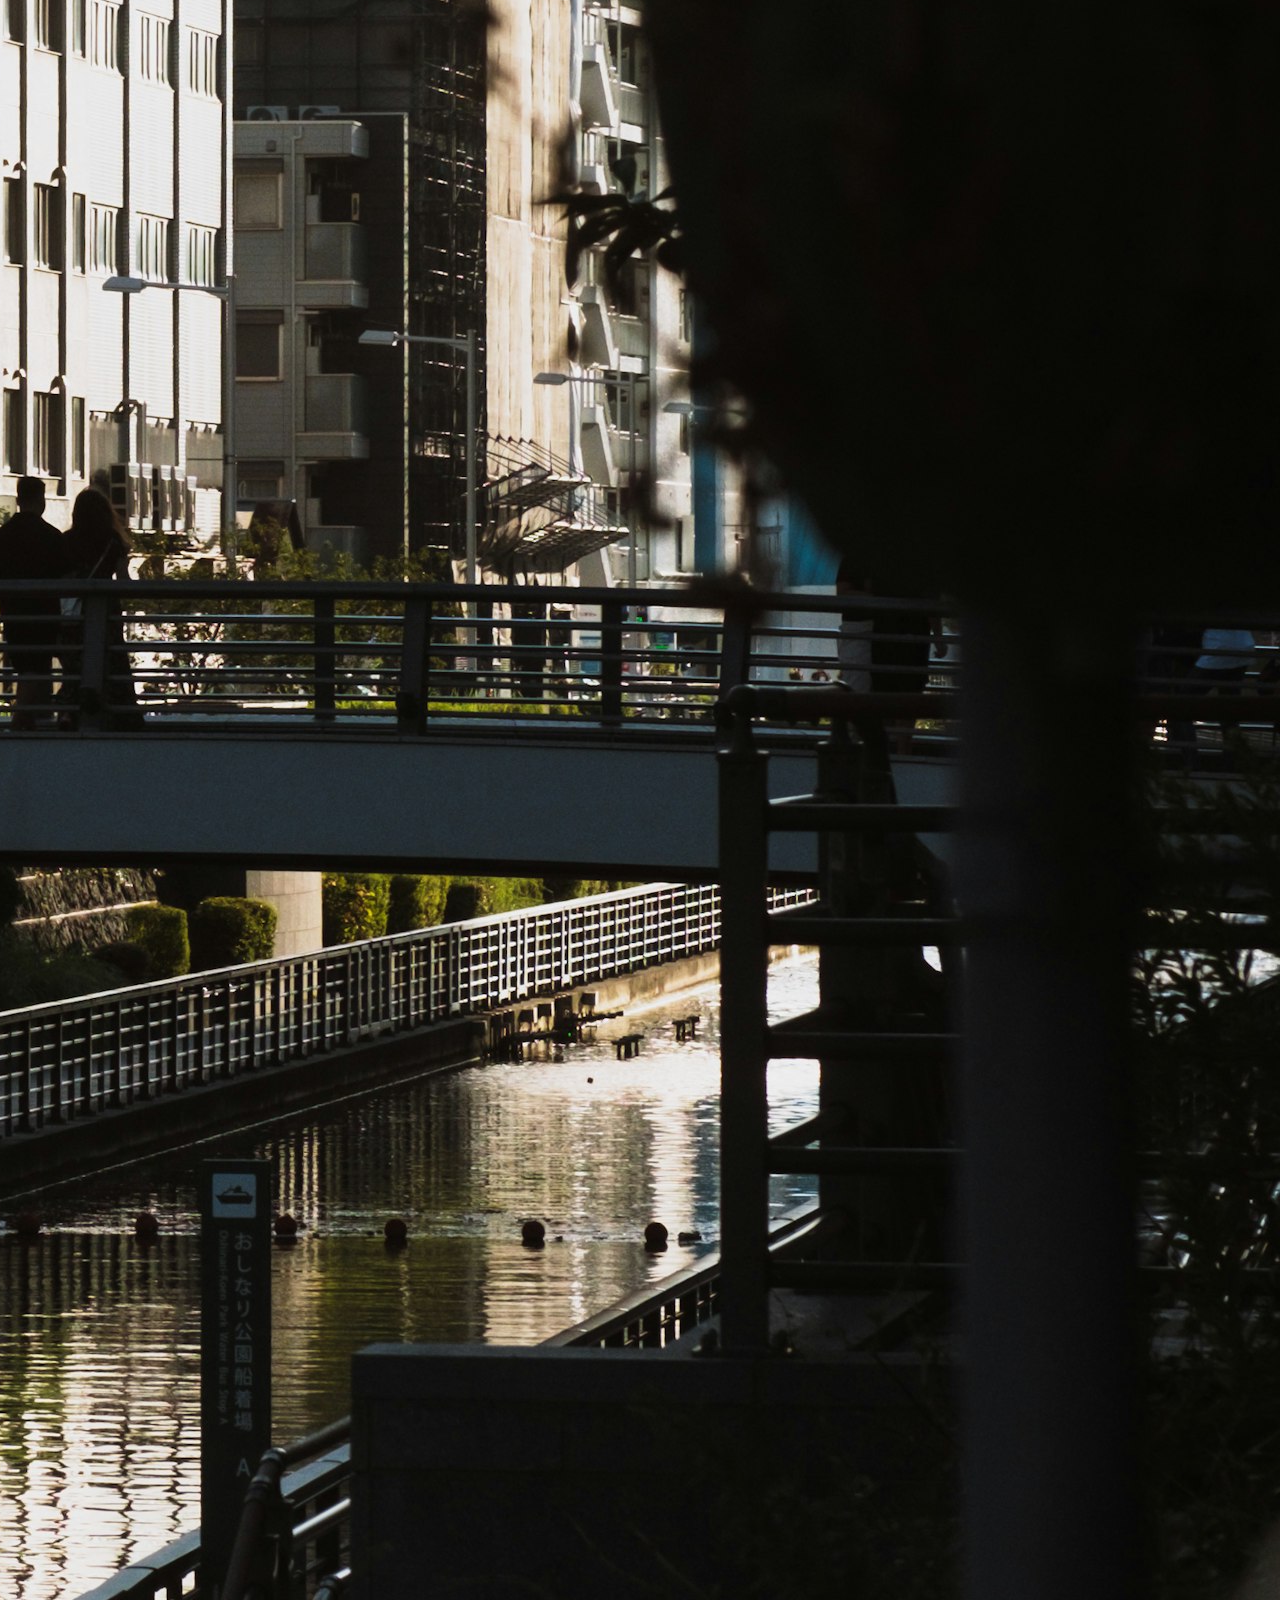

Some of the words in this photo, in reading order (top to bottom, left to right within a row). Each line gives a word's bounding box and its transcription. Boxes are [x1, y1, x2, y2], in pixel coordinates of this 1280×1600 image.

[218, 1304, 229, 1328] Park
[233, 1232, 253, 1432] おしなり公園船着場
[218, 1332, 229, 1362] Water
[218, 1366, 229, 1385] Bus
[217, 1389, 229, 1412] Stop
[235, 1457, 252, 1478] A
